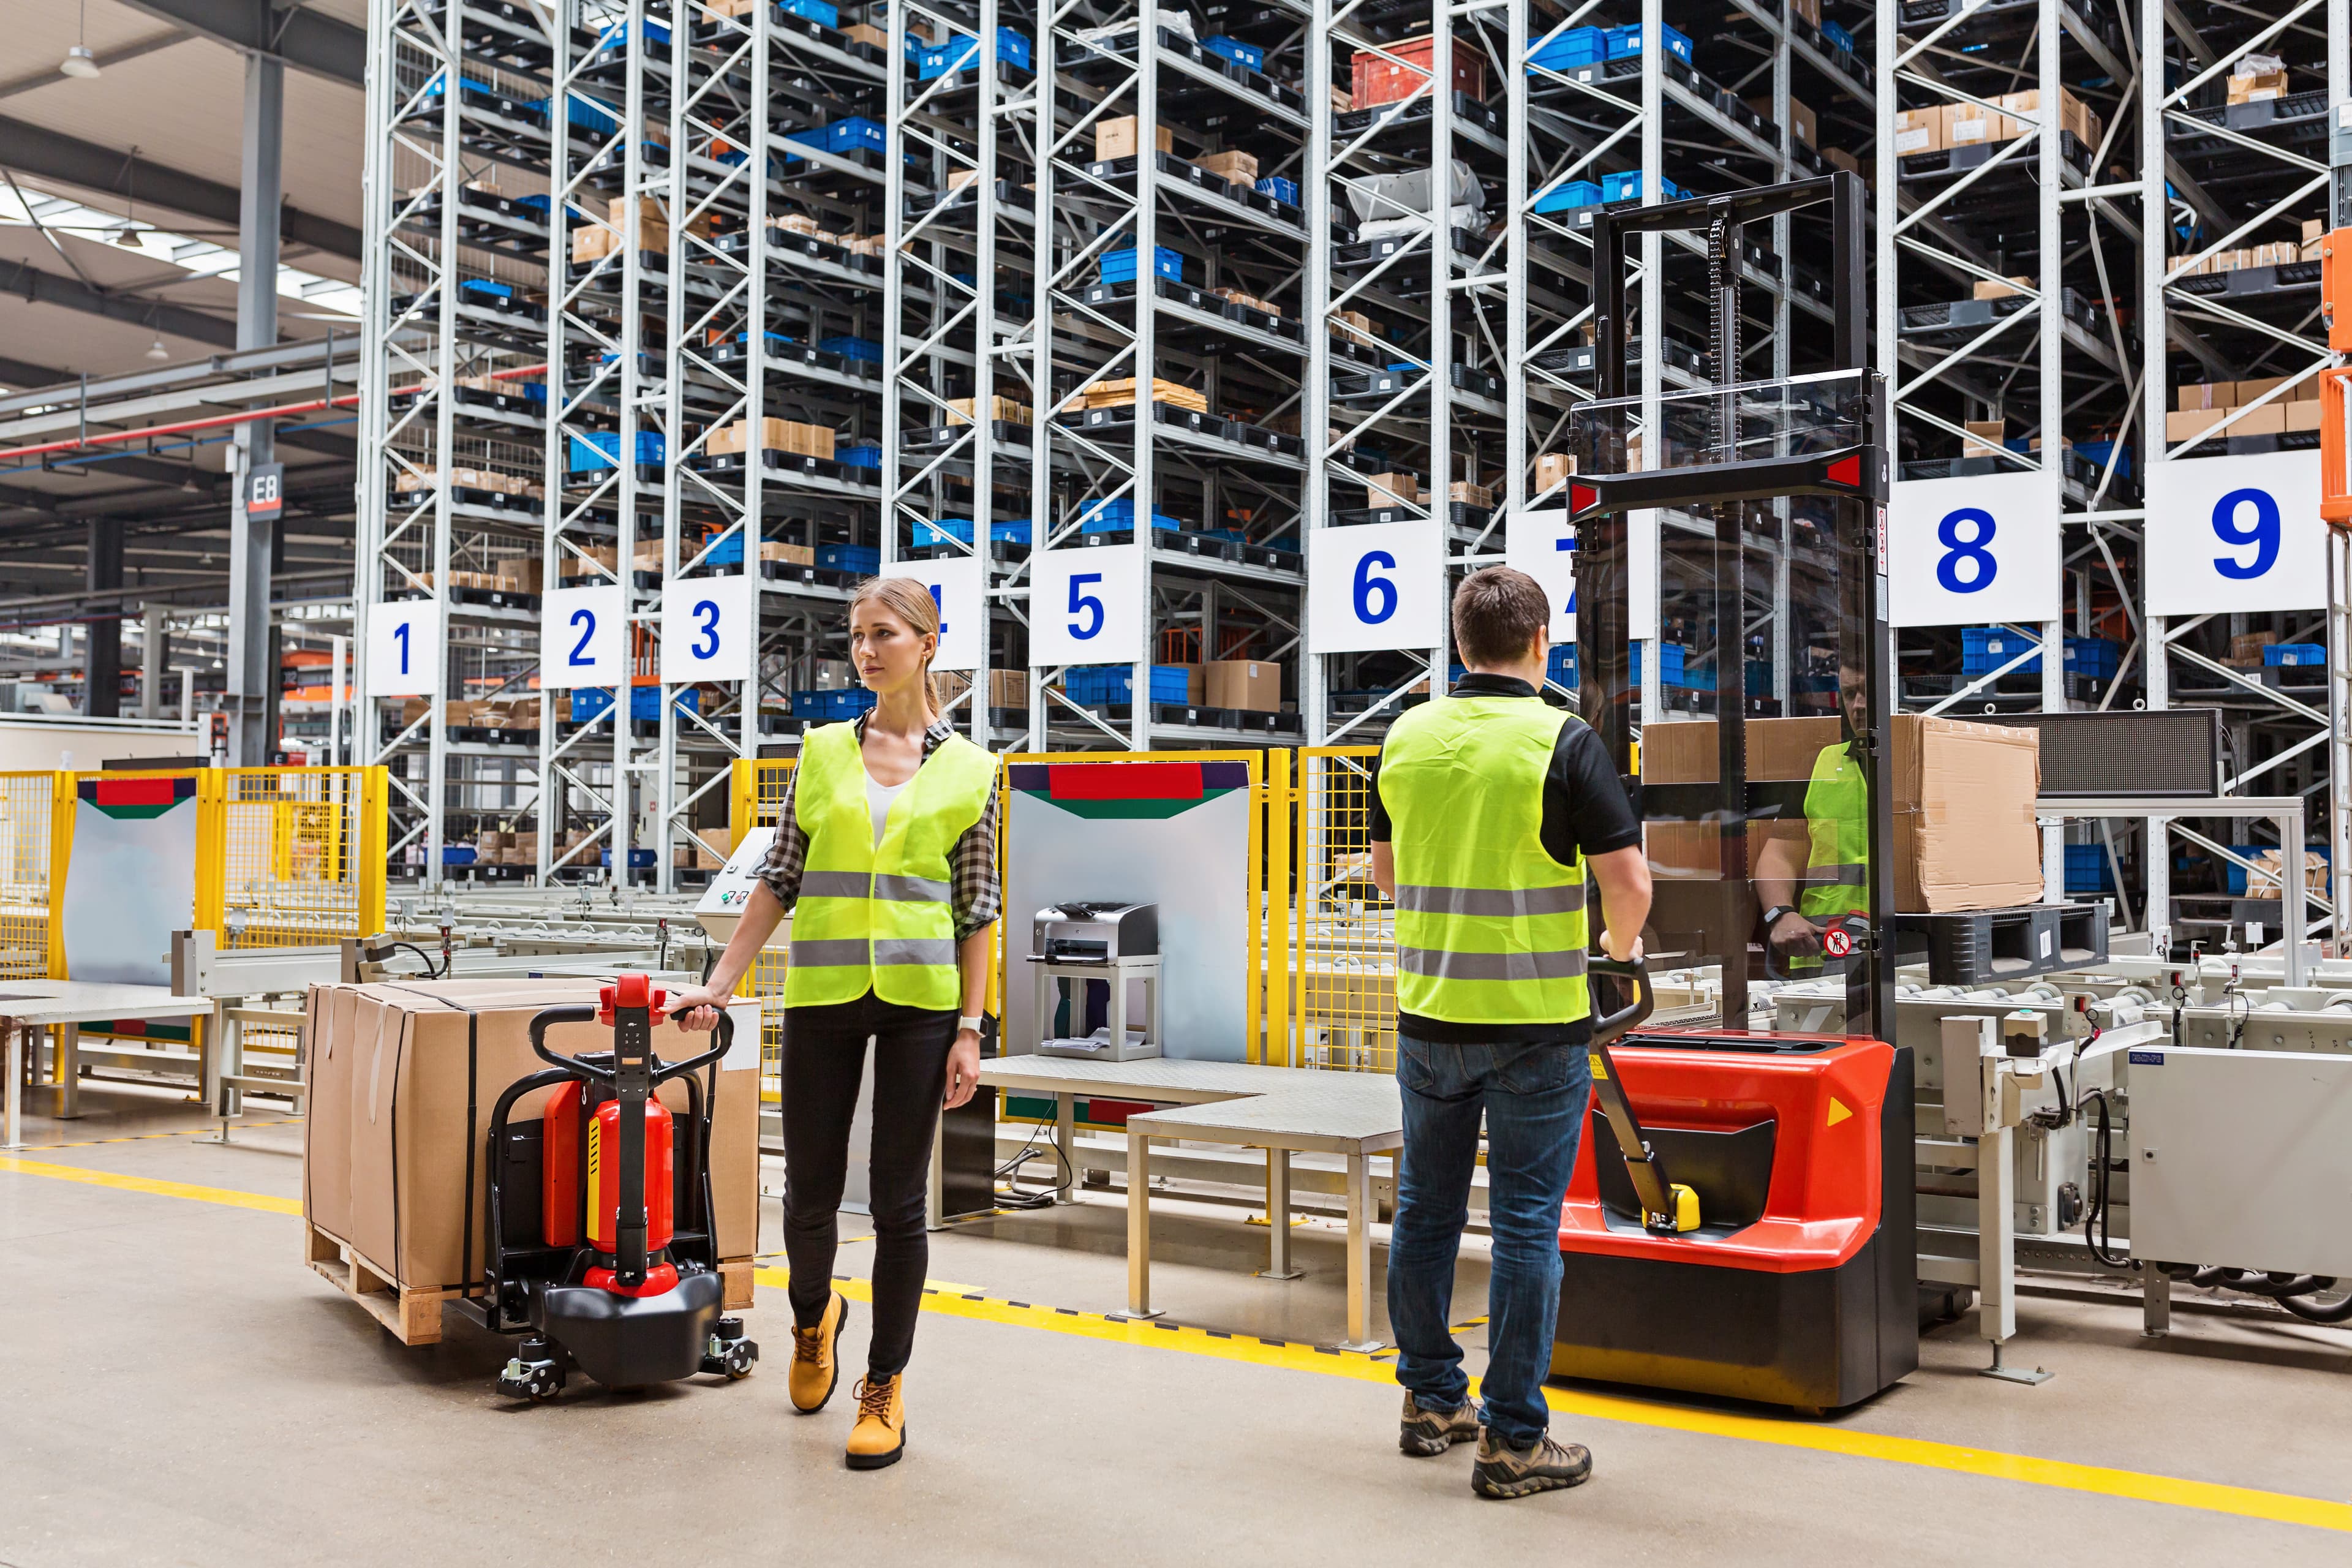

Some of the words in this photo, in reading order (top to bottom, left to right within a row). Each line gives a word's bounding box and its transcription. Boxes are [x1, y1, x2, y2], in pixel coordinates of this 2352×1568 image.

[253, 475, 277, 504] E8
[1936, 507, 1999, 595] 8
[2211, 488, 2282, 581] 9
[1068, 573, 1105, 641] 5
[1352, 550, 1399, 625] 6
[394, 622, 410, 676] 1
[568, 609, 597, 667] 2
[691, 600, 720, 660] 3
